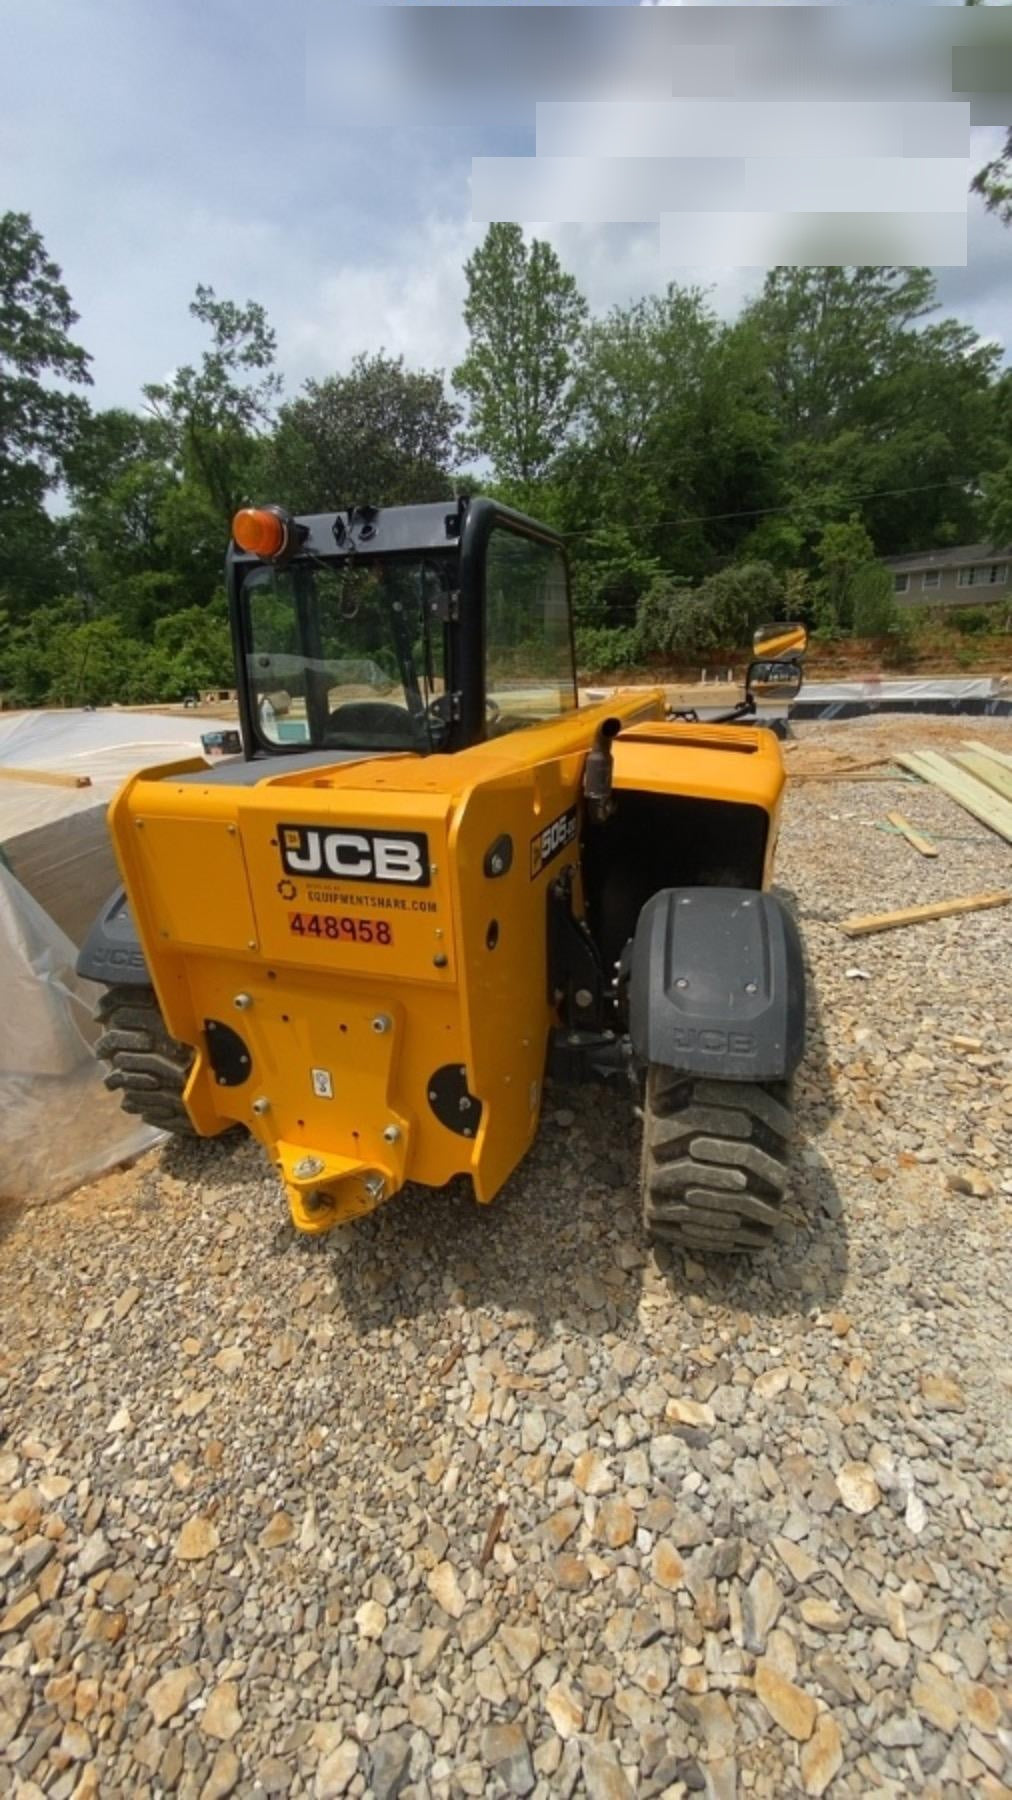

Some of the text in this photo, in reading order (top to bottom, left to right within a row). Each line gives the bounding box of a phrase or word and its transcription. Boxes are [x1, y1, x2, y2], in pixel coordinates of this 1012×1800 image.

[286, 831, 423, 882] JCB
[307, 890, 437, 913] EQUIPMENTSHARE.COM
[290, 913, 392, 945] 448958
[673, 1027, 757, 1058] JCB
